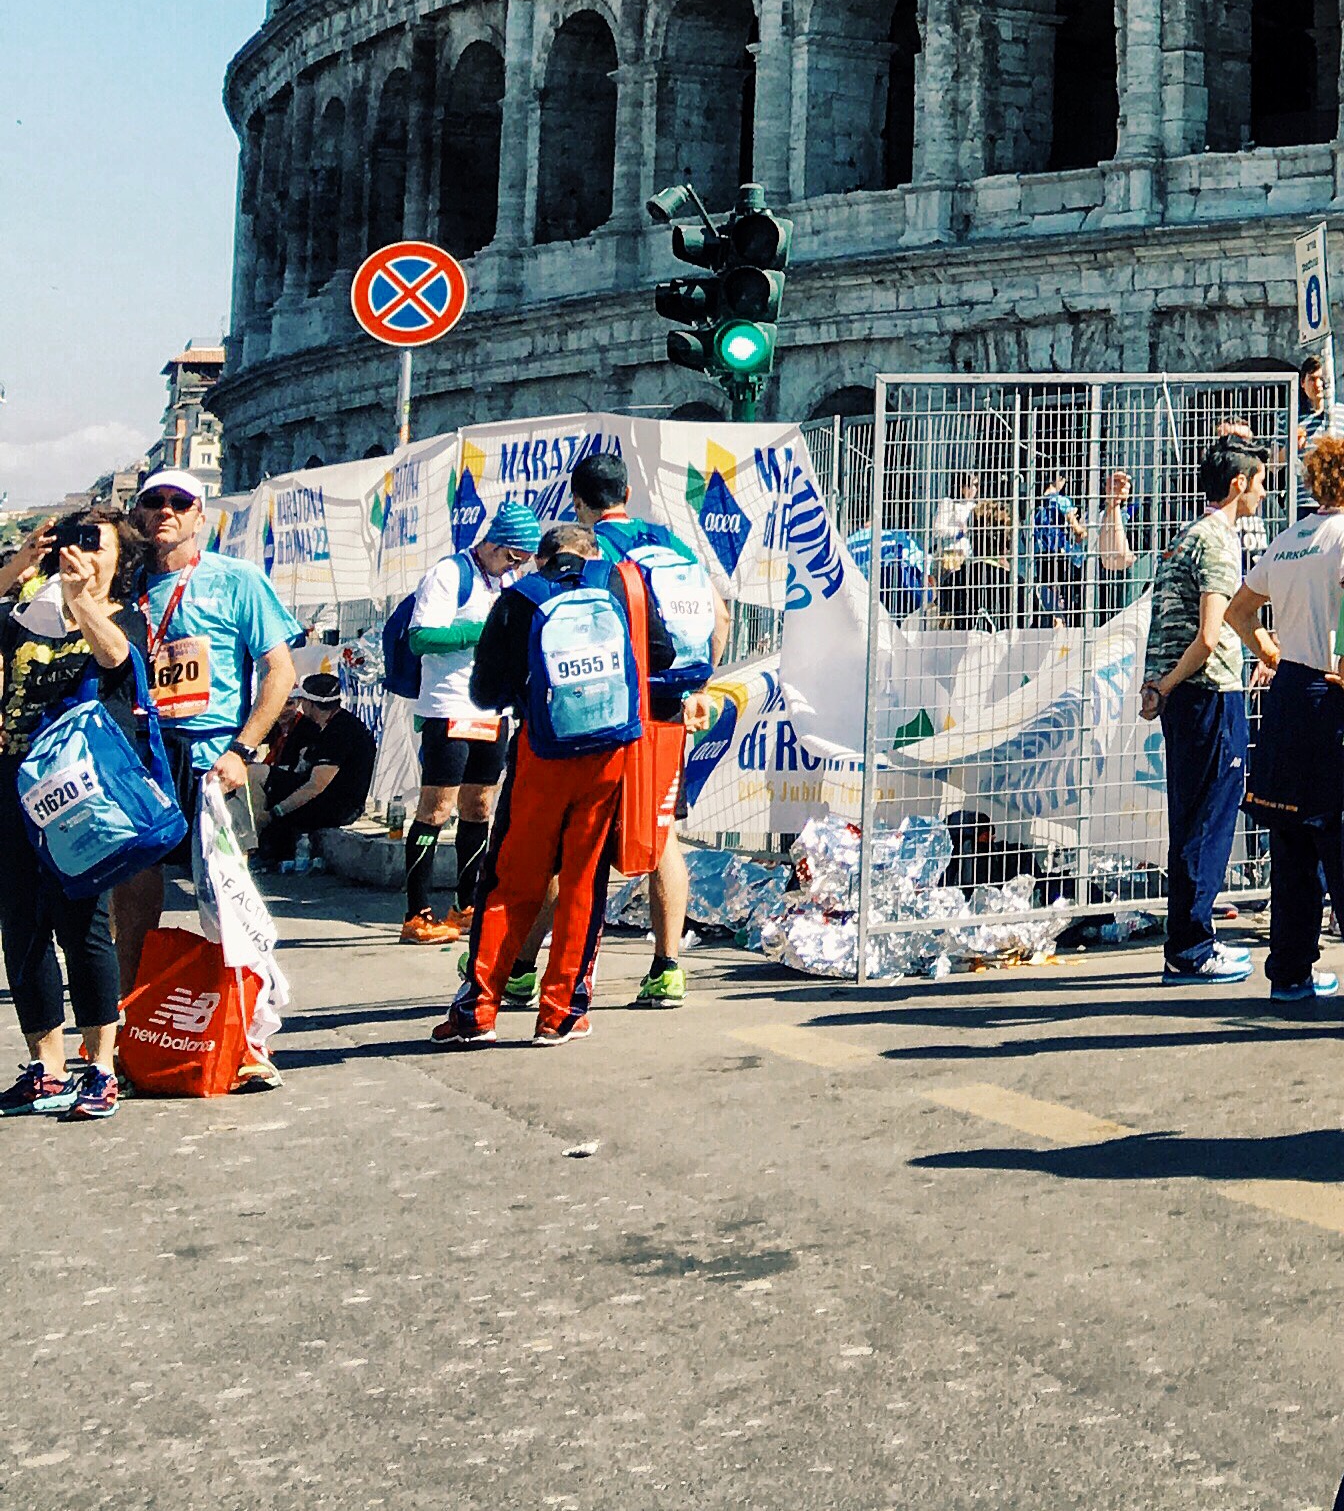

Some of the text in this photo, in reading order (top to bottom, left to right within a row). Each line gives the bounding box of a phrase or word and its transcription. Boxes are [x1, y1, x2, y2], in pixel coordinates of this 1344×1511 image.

[704, 512, 742, 534] acea
[670, 600, 700, 615] 9632
[558, 655, 605, 679] 9555
[738, 720, 767, 772] di
[129, 1026, 161, 1045] new
